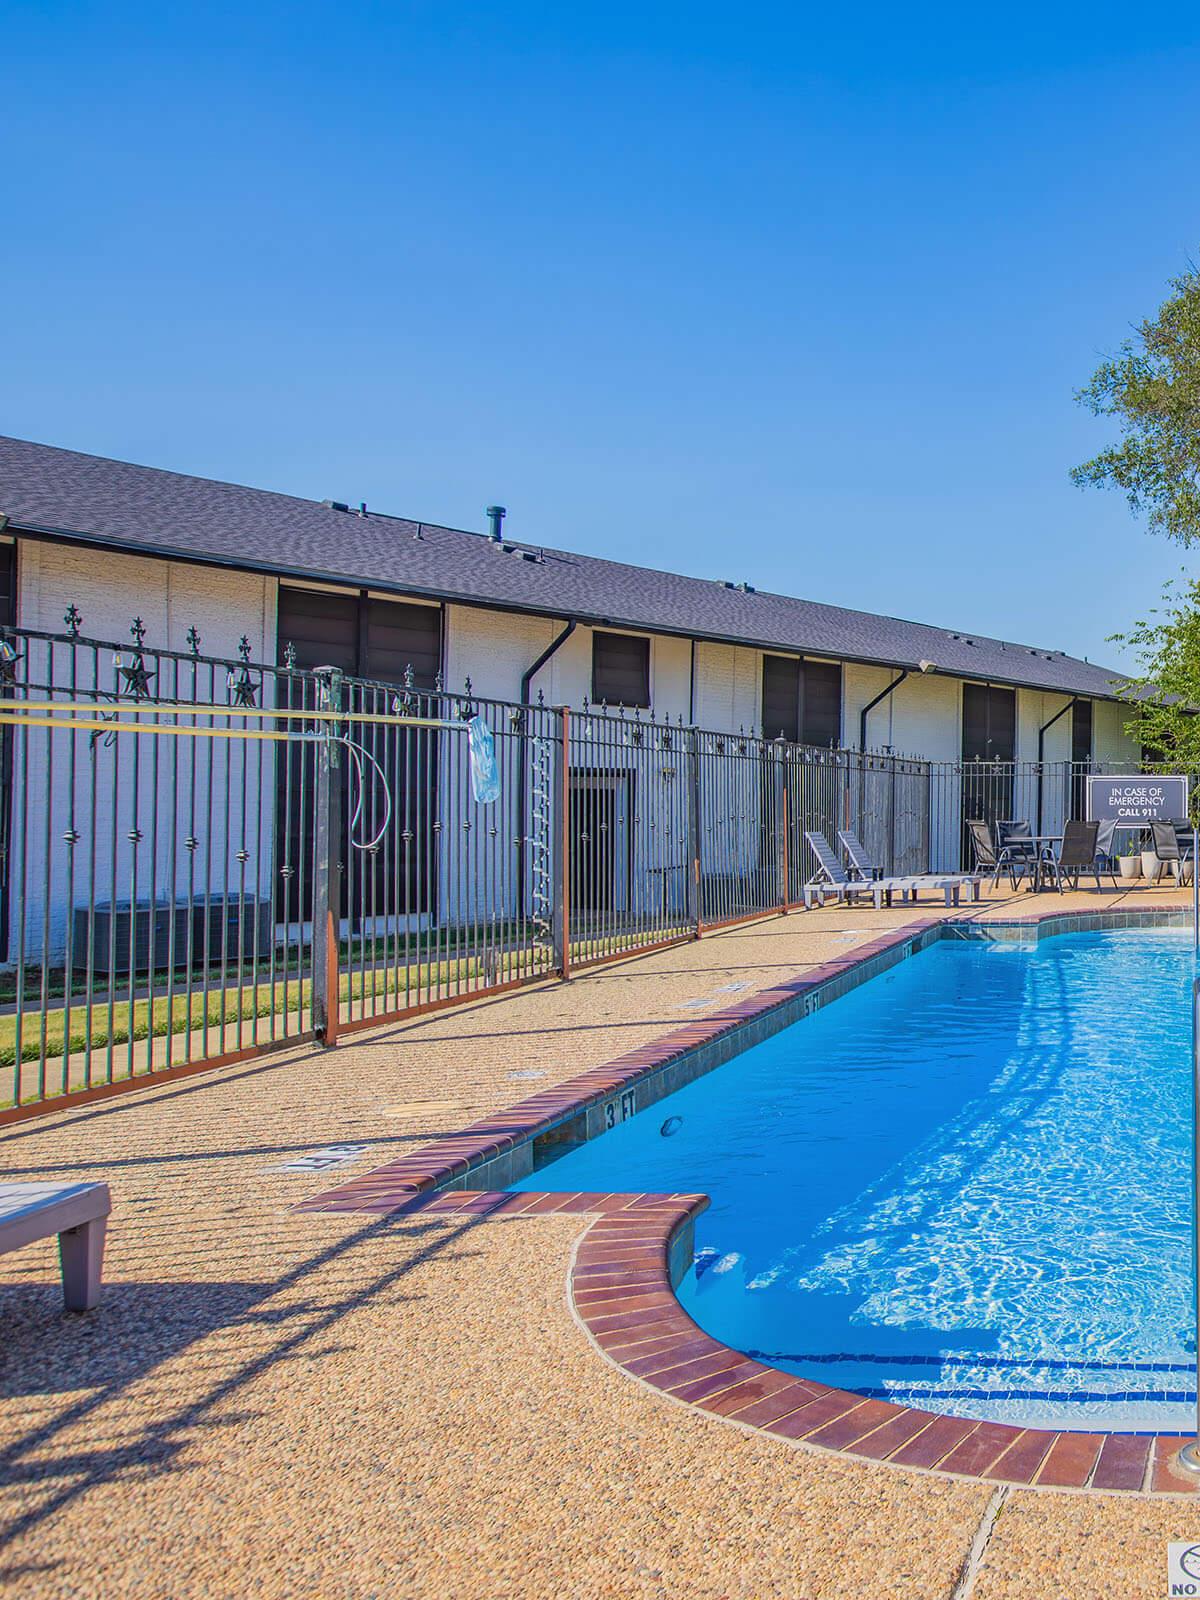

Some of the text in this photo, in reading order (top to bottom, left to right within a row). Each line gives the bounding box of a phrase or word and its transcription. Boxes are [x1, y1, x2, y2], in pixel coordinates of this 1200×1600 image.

[1111, 788, 1163, 796] IN CASE OF
[1109, 797, 1165, 806] EMERGENCY
[1118, 808, 1157, 817] CALL 911
[606, 1089, 635, 1130] 3 FT
[1172, 1583, 1198, 1595] NO
